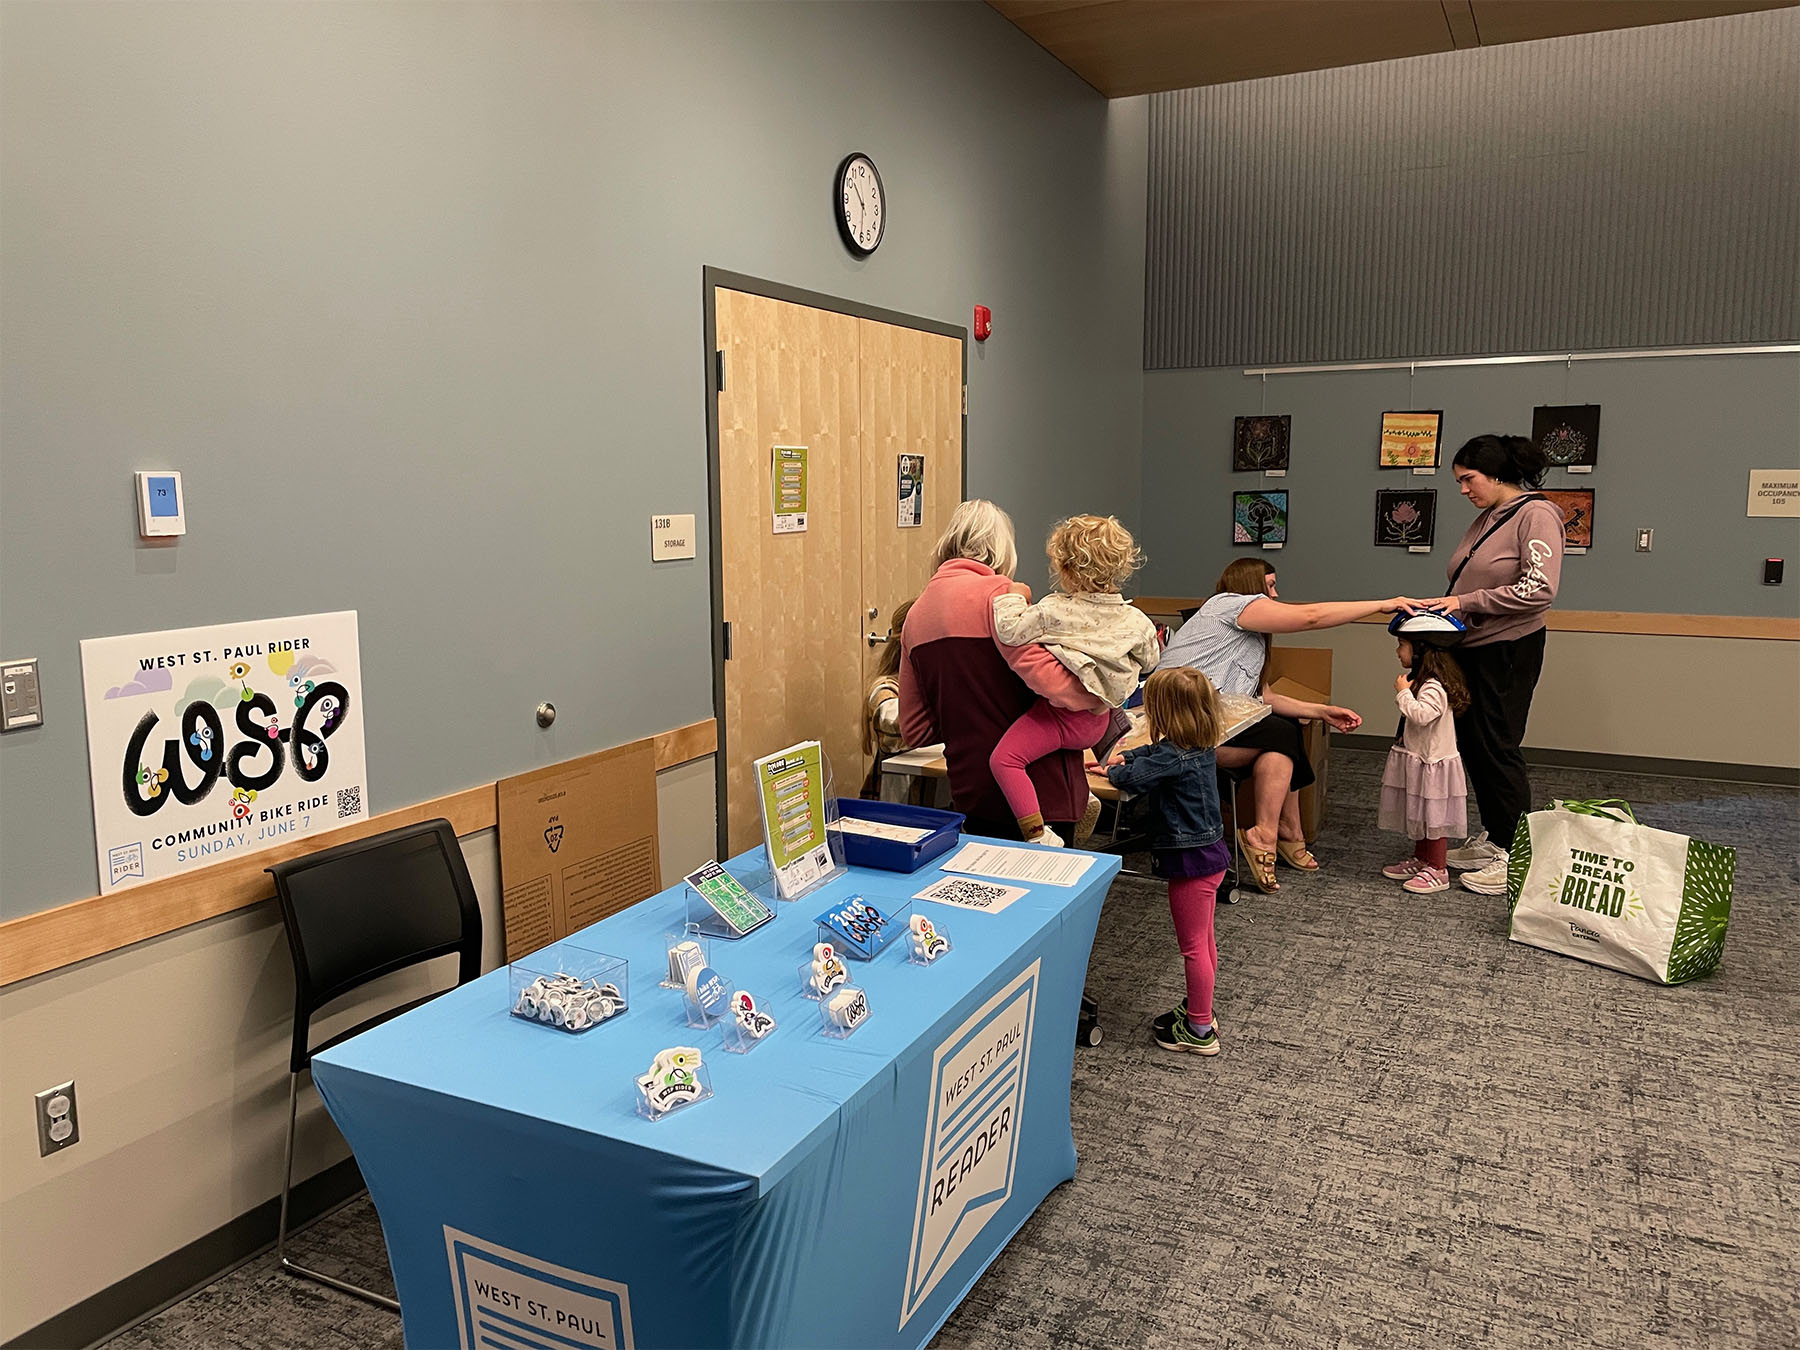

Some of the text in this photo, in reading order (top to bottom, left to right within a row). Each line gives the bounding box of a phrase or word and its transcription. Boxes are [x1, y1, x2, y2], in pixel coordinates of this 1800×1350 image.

[851, 168, 857, 179] 11
[858, 166, 865, 178] 12
[846, 177, 854, 189] 10
[868, 174, 871, 185] 1
[844, 193, 849, 204] 9
[872, 187, 877, 199] 2
[846, 210, 851, 222] 8
[874, 205, 879, 216] 3
[852, 224, 857, 235] 7
[872, 221, 877, 231] 4
[859, 232, 864, 244] 6
[866, 230, 871, 241] 5
[157, 489, 167, 497] 73
[664, 539, 686, 548] STORAGE
[1512, 539, 1553, 599] Carh
[139, 637, 311, 672] WEST ST. PAUL RIDER
[151, 794, 329, 851] COMMUNITY BIKE RIDE
[177, 815, 311, 863] SUNDAY, JUNE 7
[1570, 848, 1635, 873] TIME TO
[113, 862, 140, 874] RIDER
[1571, 863, 1626, 885] BREAK
[1560, 875, 1626, 919] BREAD
[945, 1021, 1021, 1108] WEST ST. PAUL
[930, 1105, 1011, 1217] READER
[474, 1279, 606, 1339] WEST ST. PAUL
